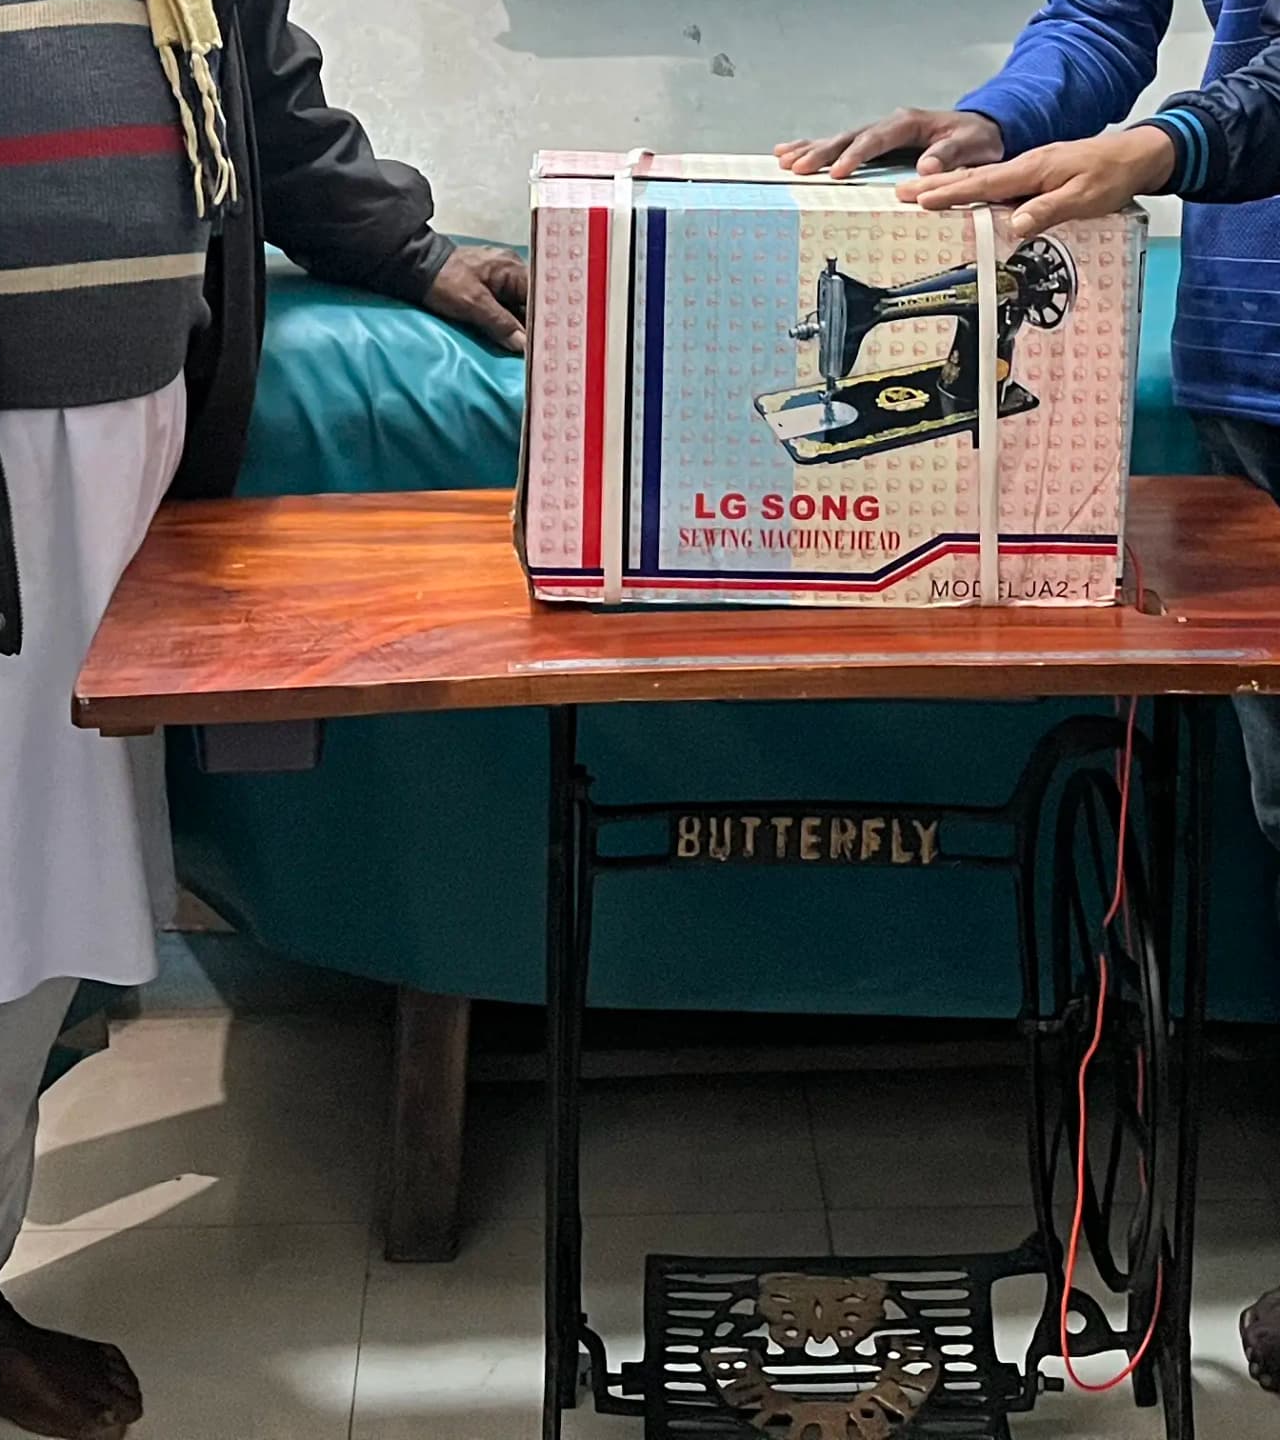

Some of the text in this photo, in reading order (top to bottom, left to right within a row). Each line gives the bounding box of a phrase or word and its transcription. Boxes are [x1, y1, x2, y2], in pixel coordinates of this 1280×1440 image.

[695, 493, 880, 522] LG SONG
[679, 527, 901, 552] SEWING MACHINE HEAD
[1025, 580, 1092, 599] JA2-1
[677, 815, 939, 864] BUTTERFLY
